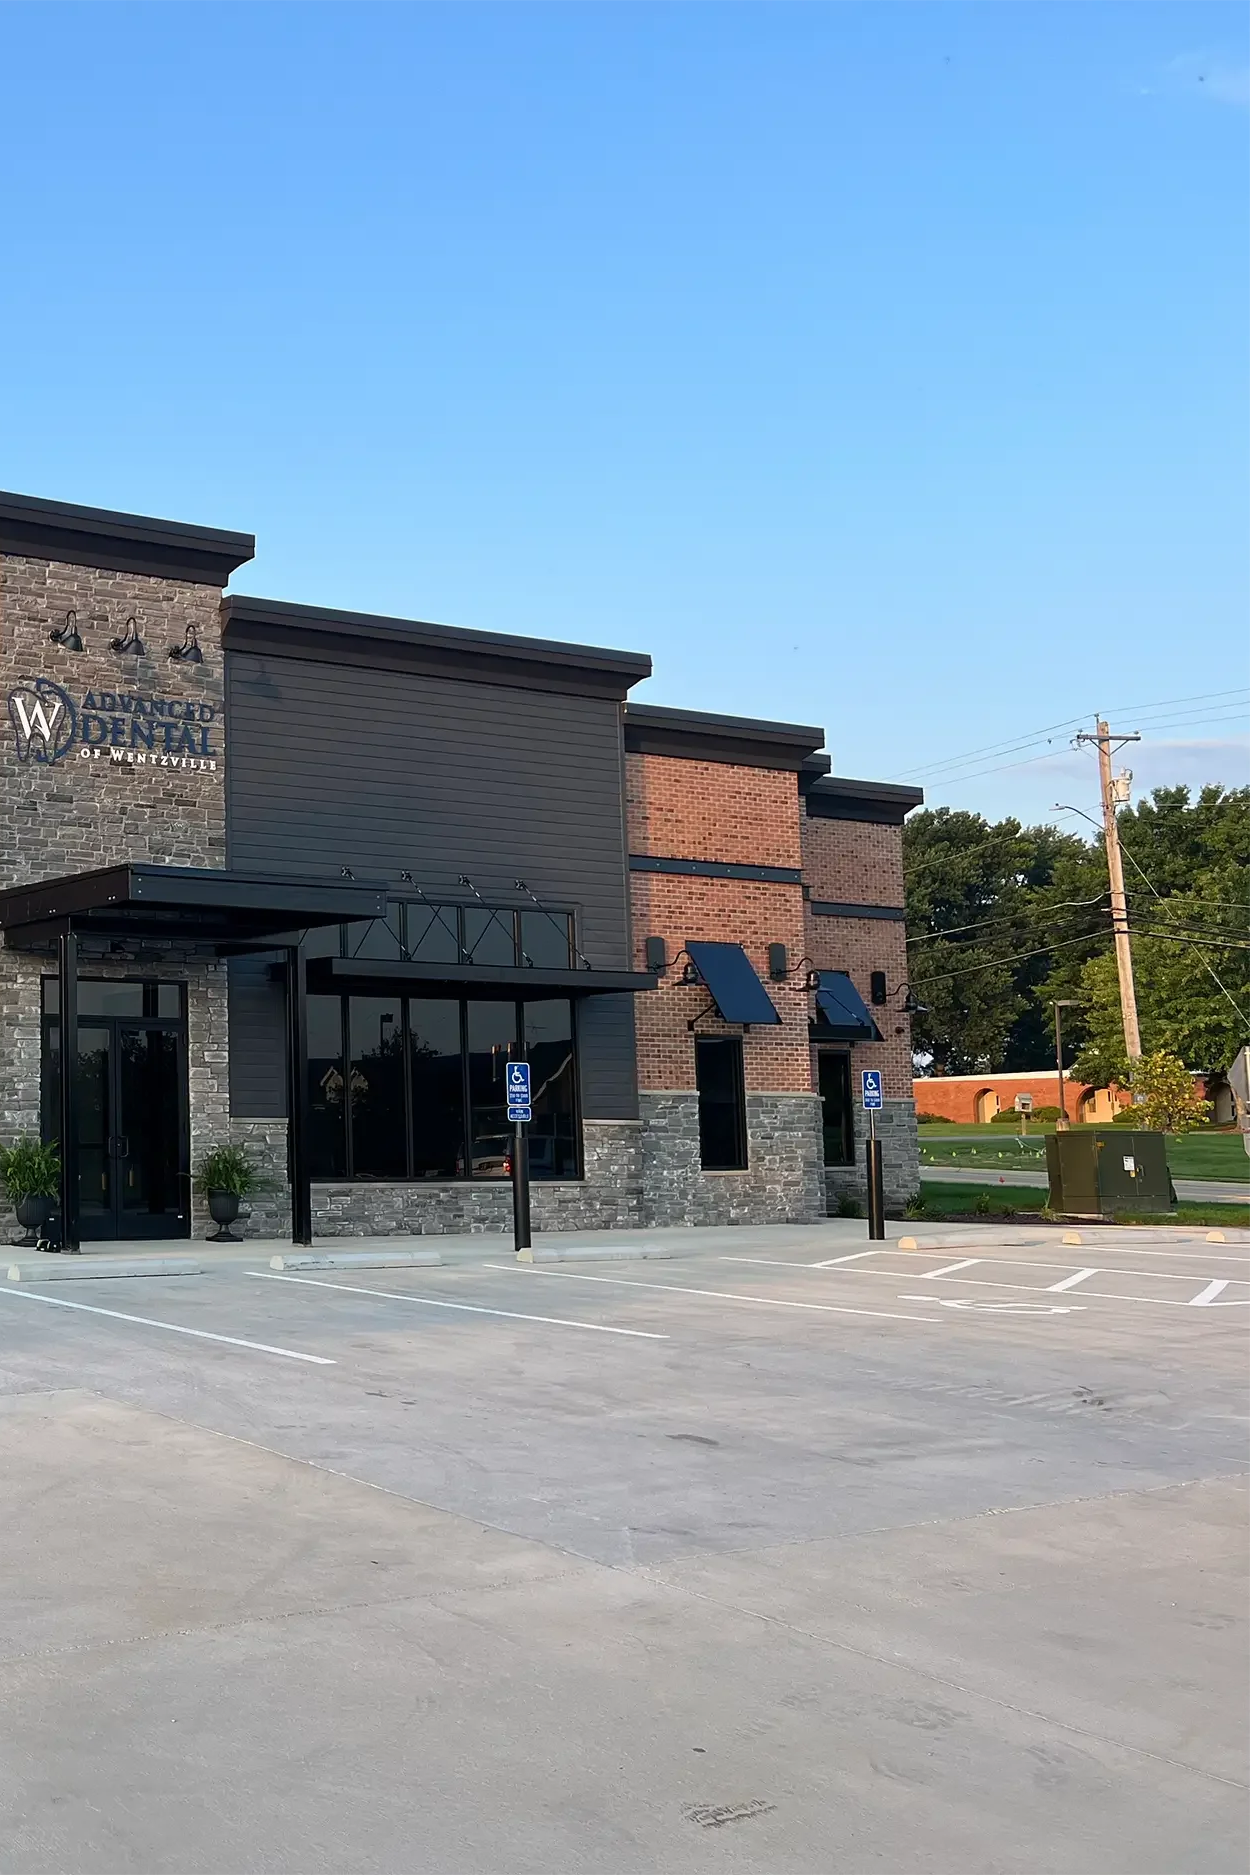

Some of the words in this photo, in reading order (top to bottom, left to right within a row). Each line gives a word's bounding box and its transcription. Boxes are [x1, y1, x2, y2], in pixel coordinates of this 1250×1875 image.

[81, 690, 215, 722] ADVANCED
[81, 713, 216, 756] DENTAL
[80, 748, 101, 759] OF
[111, 747, 217, 771] WENTZVILLE
